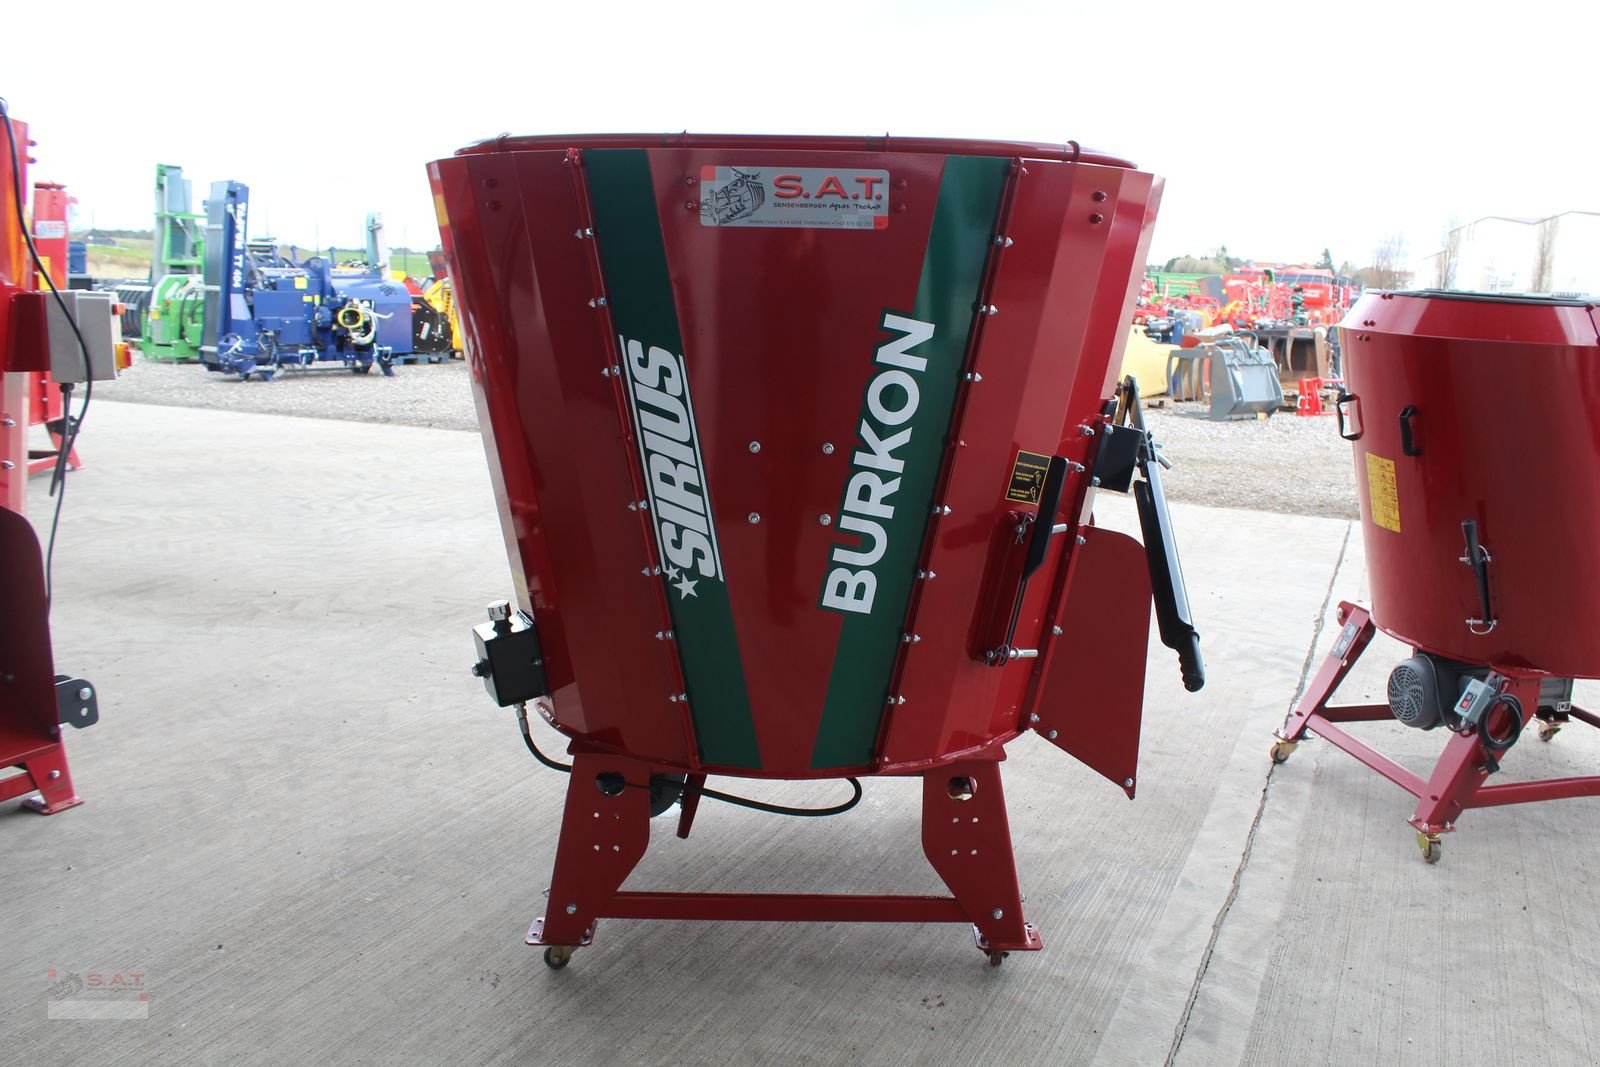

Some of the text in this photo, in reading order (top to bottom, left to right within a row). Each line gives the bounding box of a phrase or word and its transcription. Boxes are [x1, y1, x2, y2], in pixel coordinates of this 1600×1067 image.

[773, 174, 883, 200] S.A.T.
[627, 339, 716, 578] SIRIUS
[822, 313, 935, 615] BURKON
